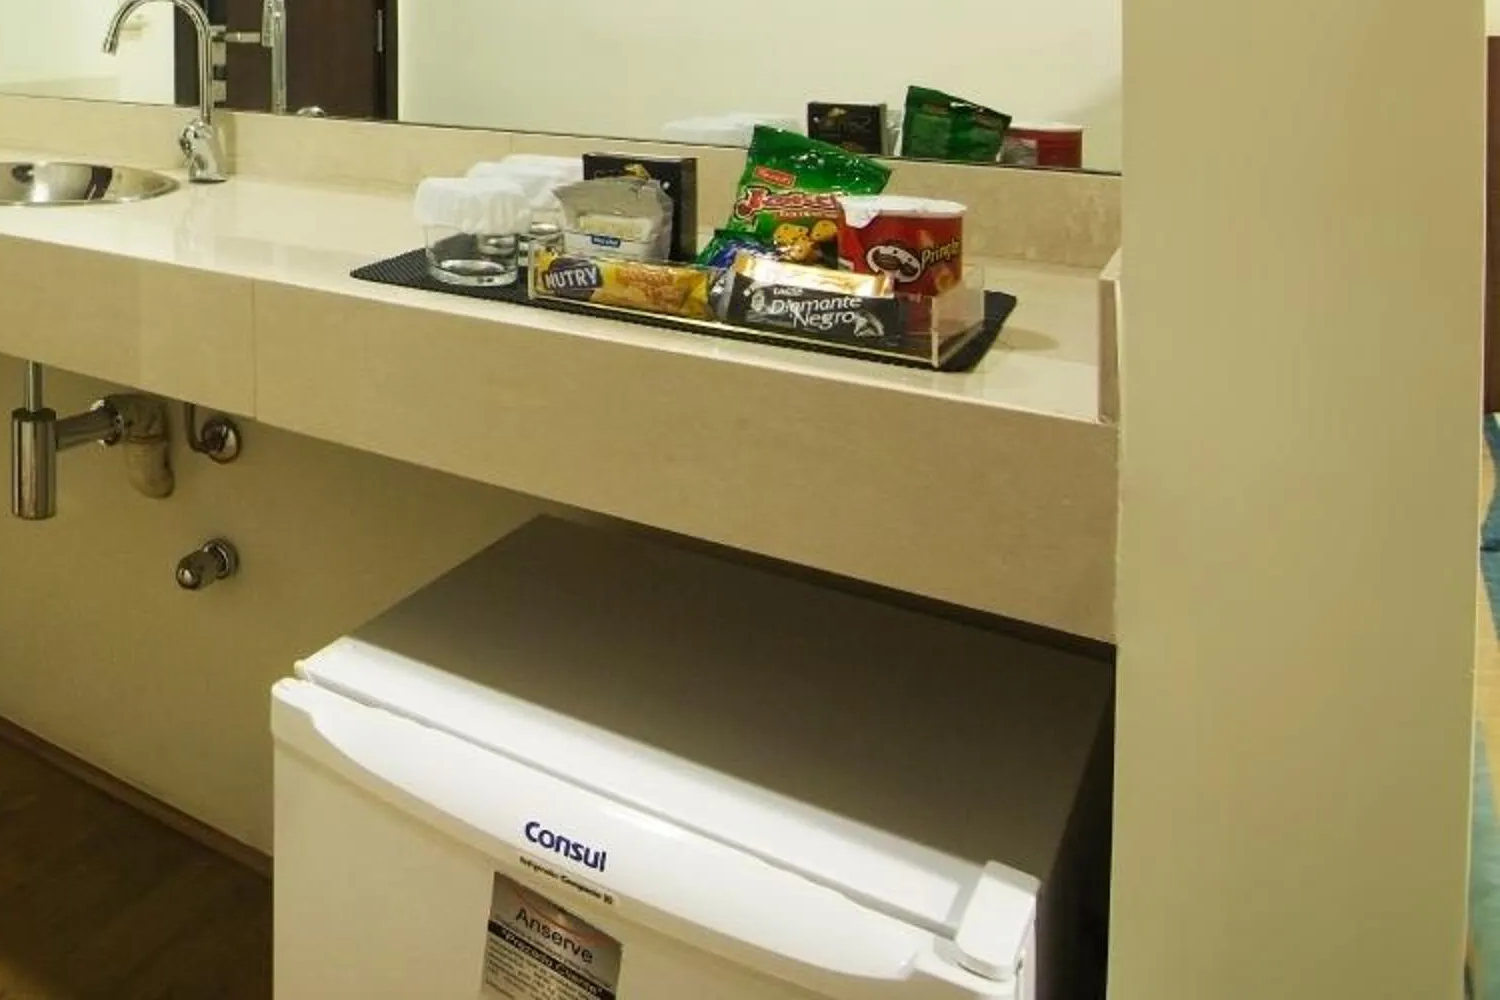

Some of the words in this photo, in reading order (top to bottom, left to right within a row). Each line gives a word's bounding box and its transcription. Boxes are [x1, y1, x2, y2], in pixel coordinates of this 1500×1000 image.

[544, 267, 598, 290] NUTRY
[770, 296, 862, 315] Diamante
[790, 311, 855, 331] Negro
[515, 906, 593, 964] Anserve
